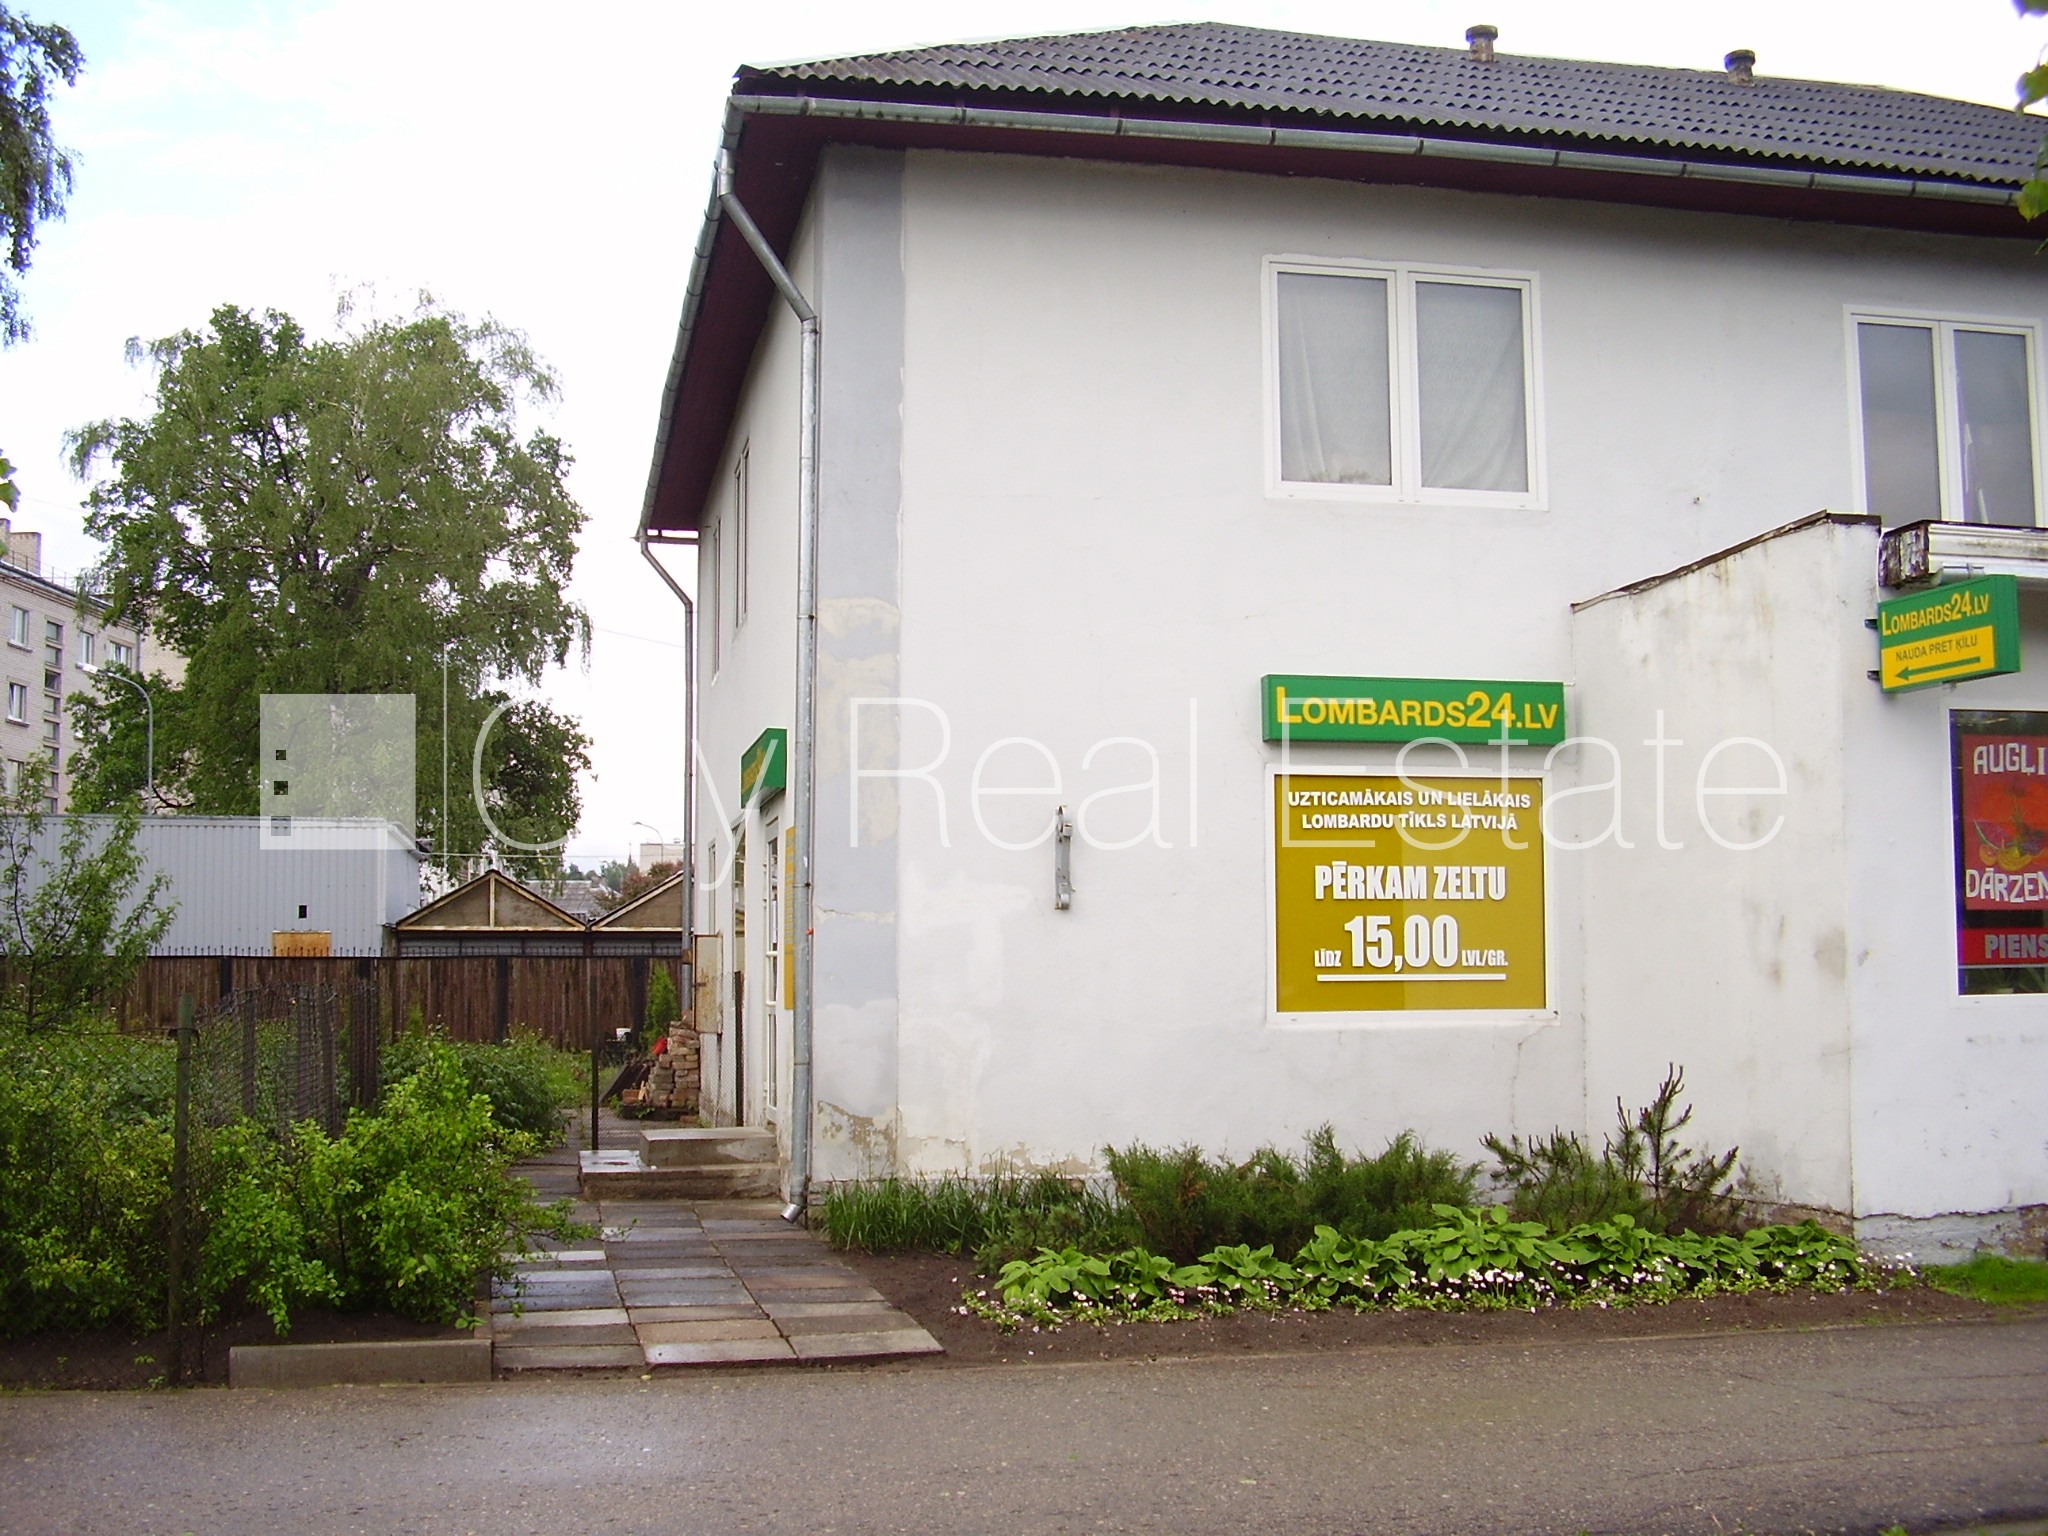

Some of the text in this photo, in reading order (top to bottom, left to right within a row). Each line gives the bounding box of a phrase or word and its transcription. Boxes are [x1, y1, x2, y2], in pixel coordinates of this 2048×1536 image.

[1882, 591, 1990, 636] LOMBARDS24.LV
[1895, 646, 1927, 662] NAUDA
[1928, 640, 1953, 655] PRET
[1276, 686, 1558, 729] LOMBARDS24.LV
[1288, 788, 1532, 809] UZTICAMĀKAIS UN LIELĀKAIS
[1302, 811, 1518, 831] LOMBARDU TĪKLS LATVIJĀ
[1314, 860, 1507, 901] PĒRKAM ZELTU
[1314, 914, 1509, 973] LĪDZ 15,00 LVL/GR.
